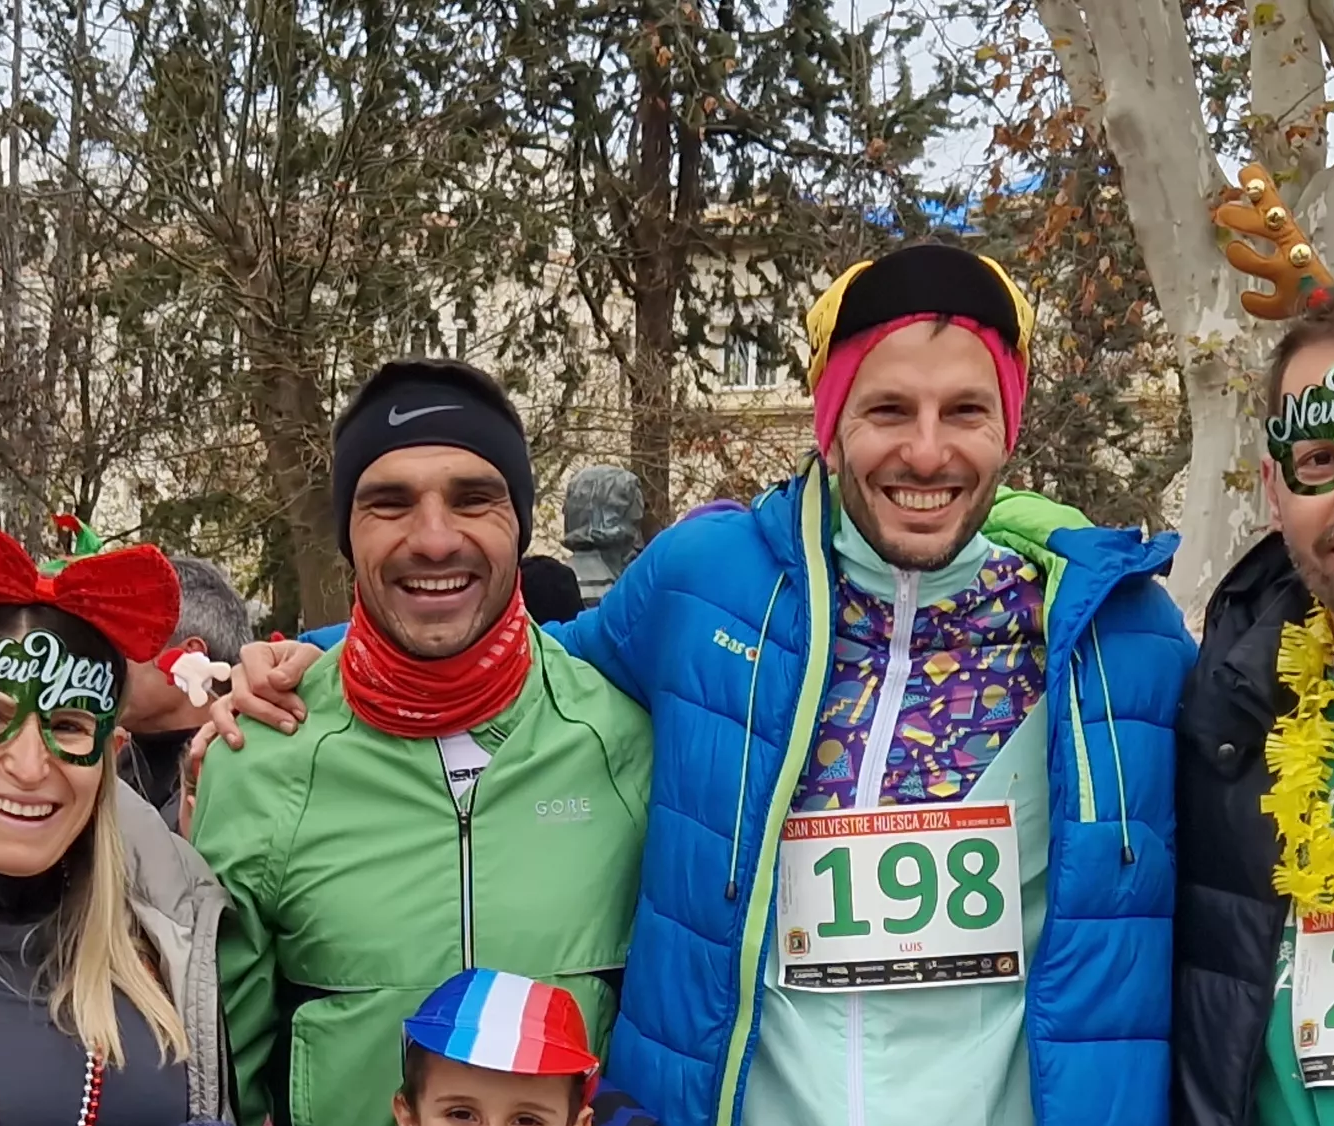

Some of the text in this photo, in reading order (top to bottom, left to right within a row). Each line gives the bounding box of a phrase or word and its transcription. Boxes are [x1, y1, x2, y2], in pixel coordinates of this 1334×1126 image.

[24, 631, 114, 711] Year
[535, 797, 591, 815] GORE
[787, 820, 809, 838] SAN
[811, 817, 871, 836] SILVESTRE
[873, 814, 920, 832] HUESCA
[922, 811, 951, 829] 2024
[813, 838, 1005, 938] 198
[1311, 911, 1333, 930] SAN
[899, 941, 923, 952] LUIS
